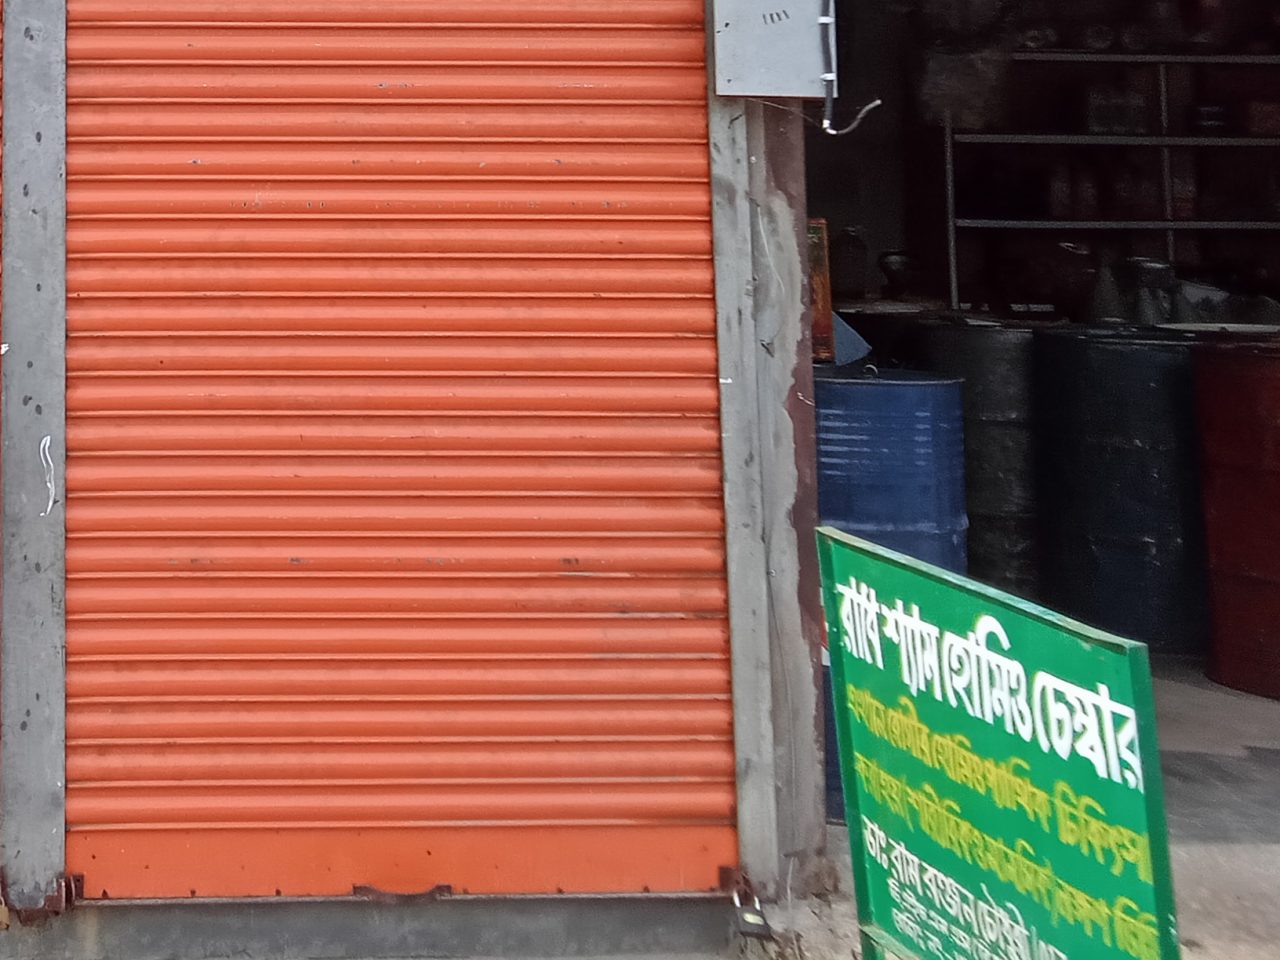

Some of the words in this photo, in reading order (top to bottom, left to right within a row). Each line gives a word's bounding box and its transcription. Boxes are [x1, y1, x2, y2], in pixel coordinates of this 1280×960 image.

[880, 598, 943, 702] শ্যাম
[942, 614, 1034, 742] হোমিও
[1033, 671, 1145, 794] চেম্বার
[887, 837, 924, 896] রাম
